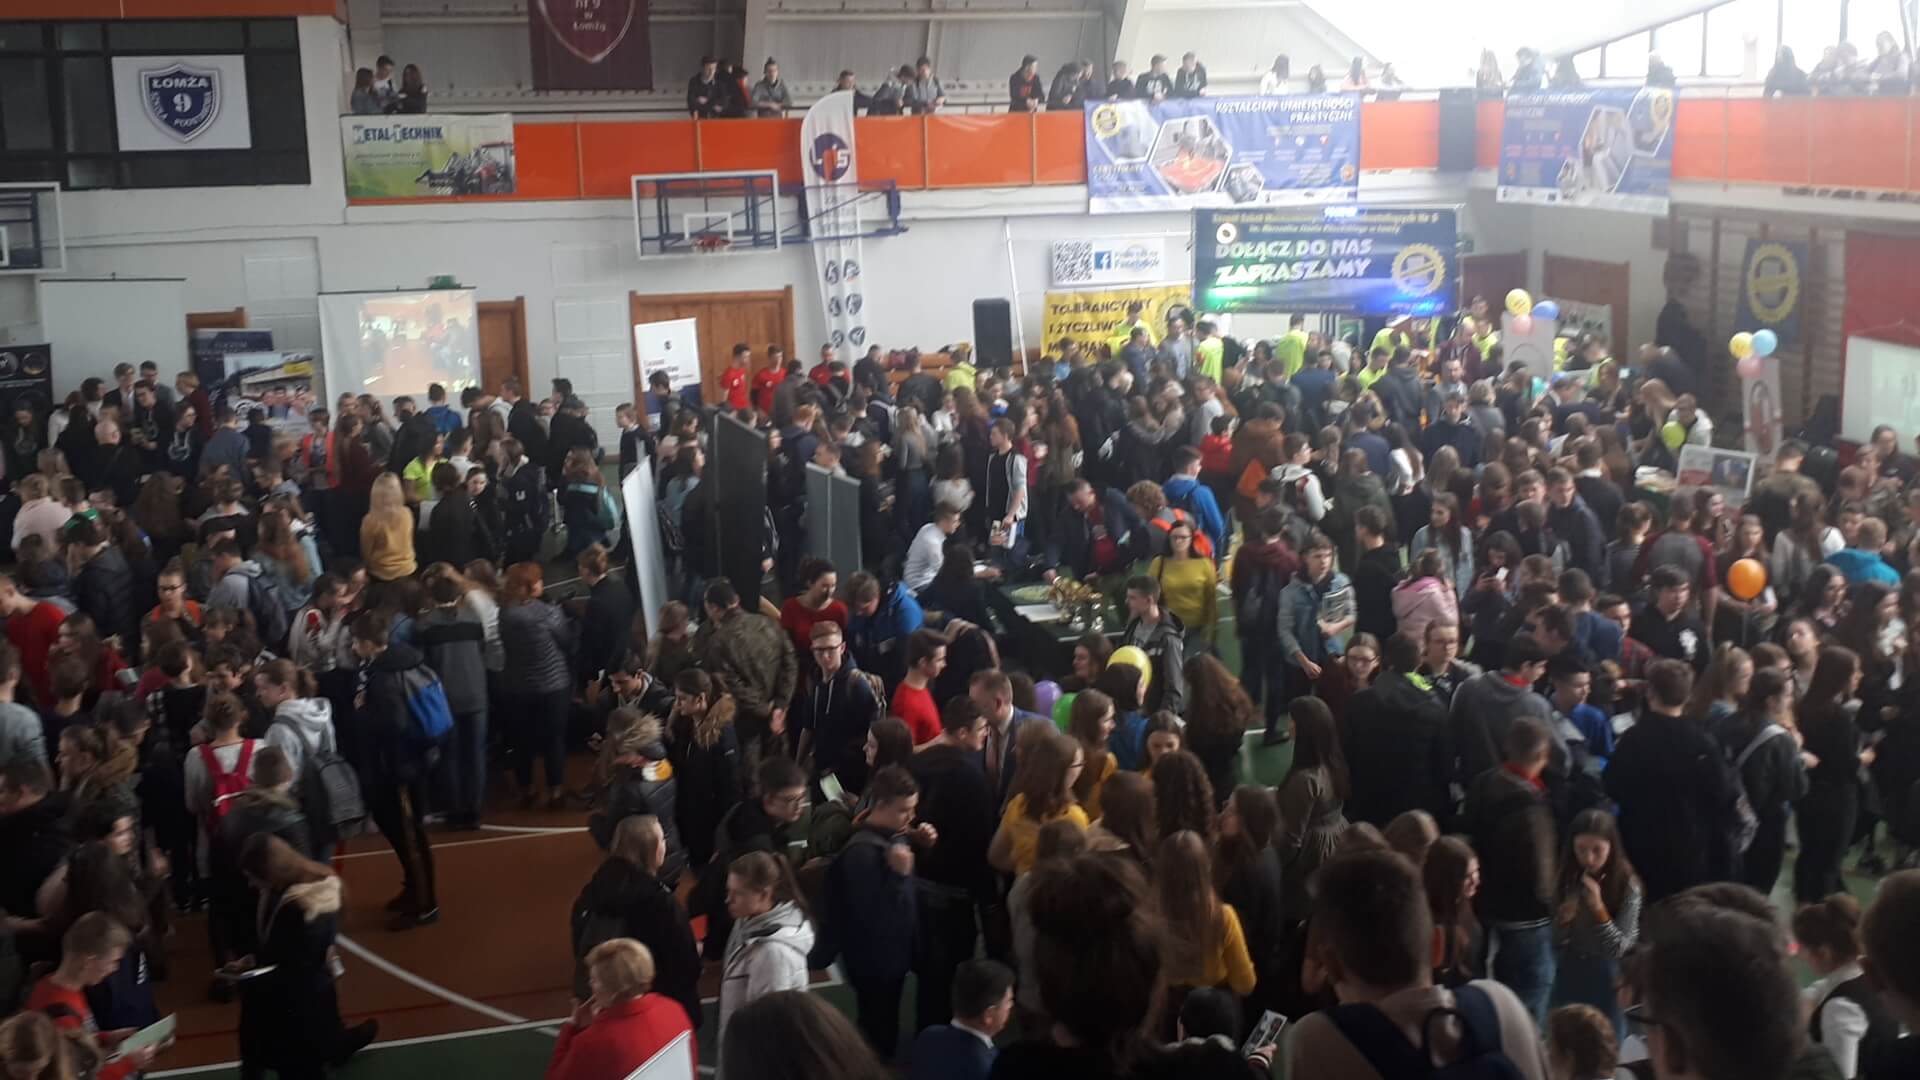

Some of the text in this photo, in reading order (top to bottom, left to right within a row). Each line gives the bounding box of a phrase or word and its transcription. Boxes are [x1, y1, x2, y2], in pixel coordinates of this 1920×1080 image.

[152, 77, 209, 88] ŁOMŻA
[173, 93, 192, 112] 9
[1216, 239, 1373, 261] DOŁĄCZ DO NAS
[1215, 258, 1371, 286] ZAPRASZAMY
